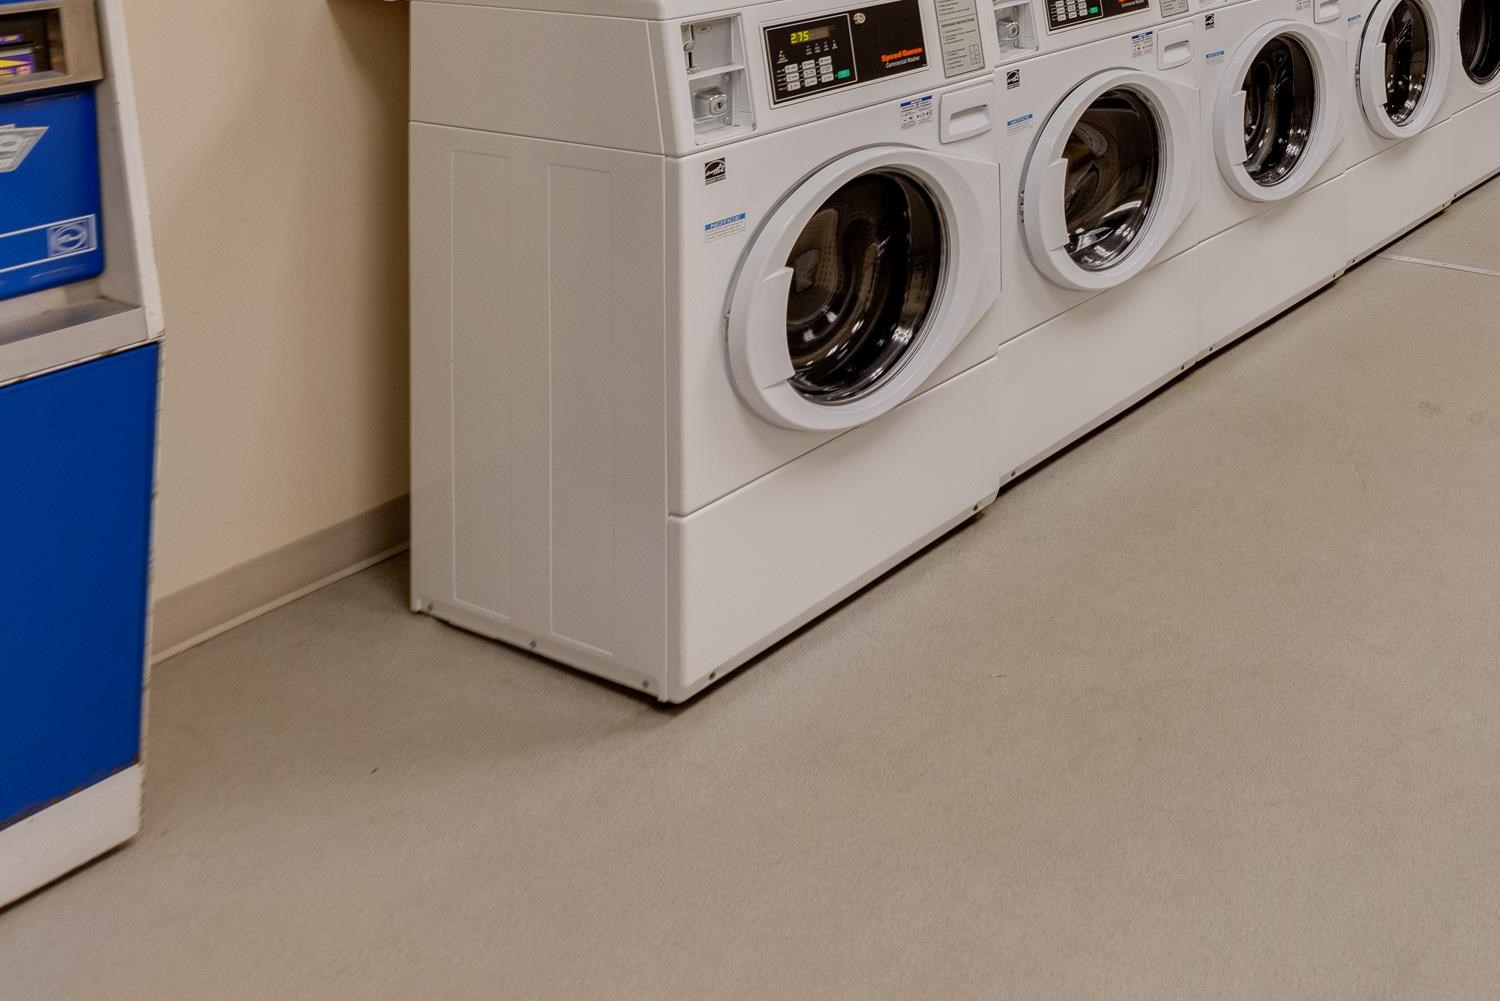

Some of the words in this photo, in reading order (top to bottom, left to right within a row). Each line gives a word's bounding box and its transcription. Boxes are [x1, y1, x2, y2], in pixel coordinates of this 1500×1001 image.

[881, 51, 902, 63] Speed
[902, 48, 923, 57] Queen
[710, 216, 738, 229] NOTICE
